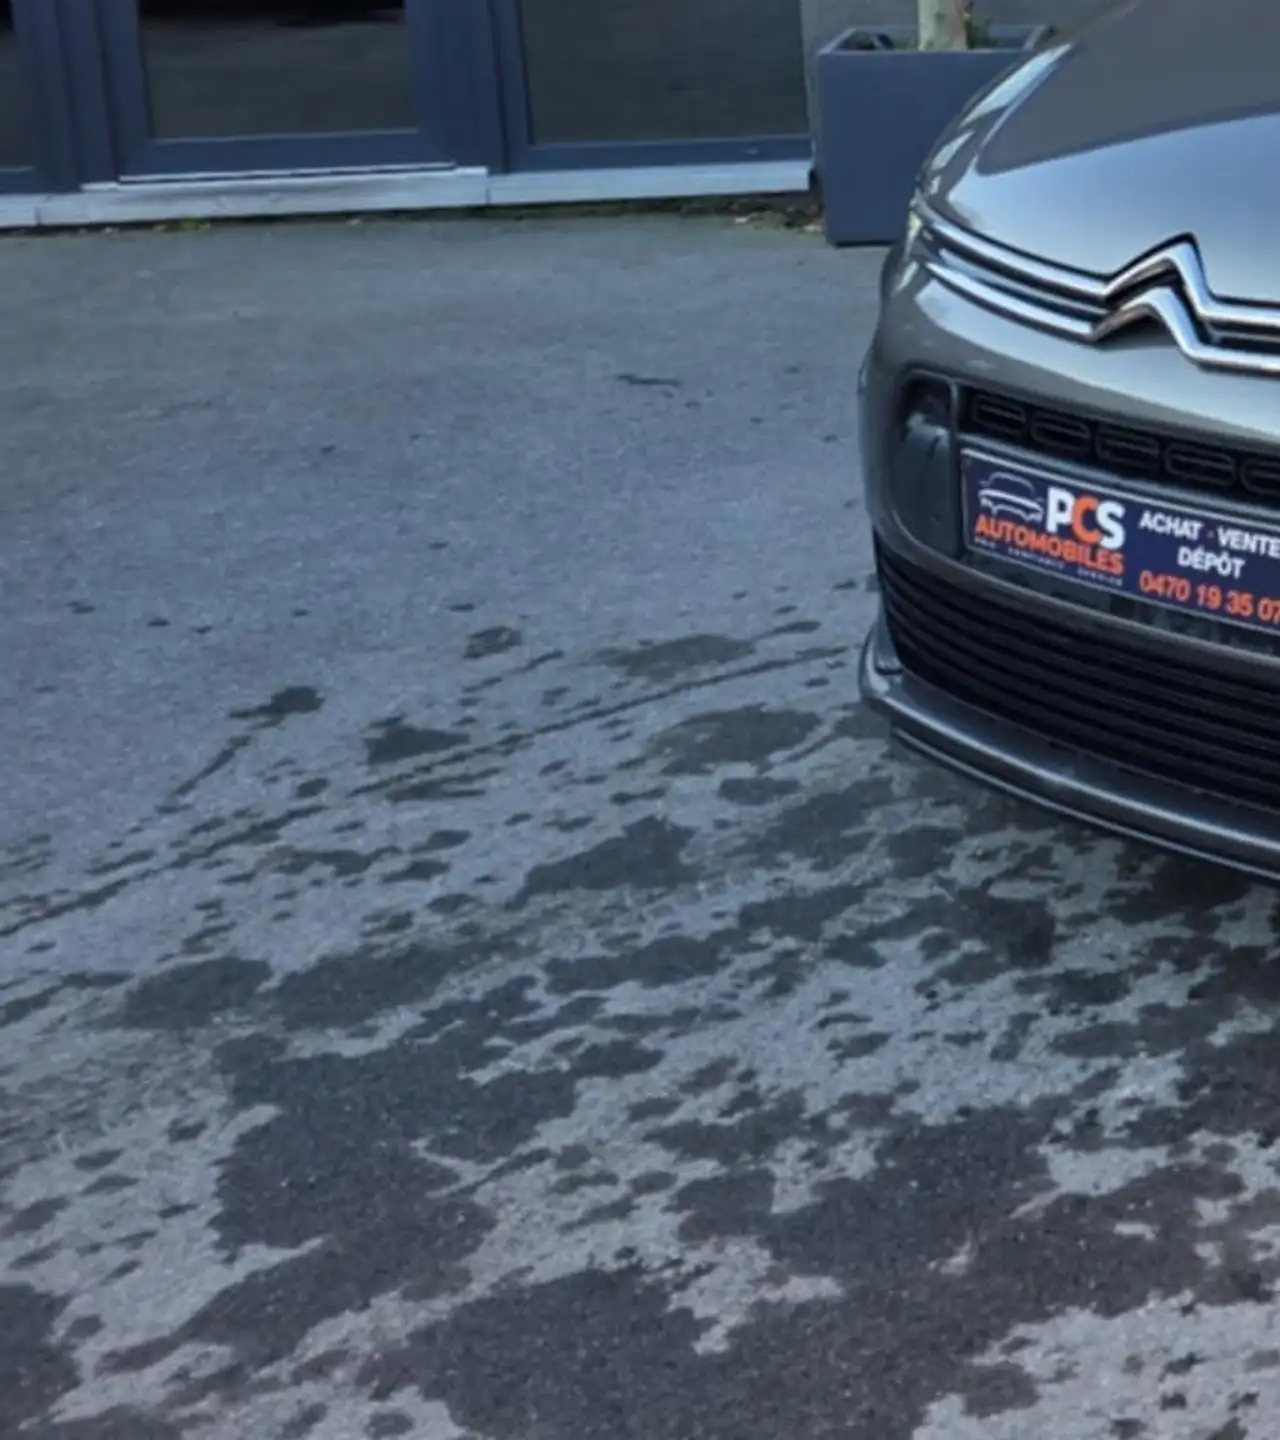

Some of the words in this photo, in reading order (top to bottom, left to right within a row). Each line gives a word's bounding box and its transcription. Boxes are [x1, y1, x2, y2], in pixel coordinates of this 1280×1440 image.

[1046, 487, 1126, 550] PCS
[1139, 510, 1203, 541] ACHAT
[975, 514, 1125, 576] AUTOMOBILES
[1177, 545, 1246, 579] DÉPÔT
[1139, 570, 1190, 603] 0470
[1197, 585, 1222, 609] 19
[1226, 592, 1254, 615] 35
